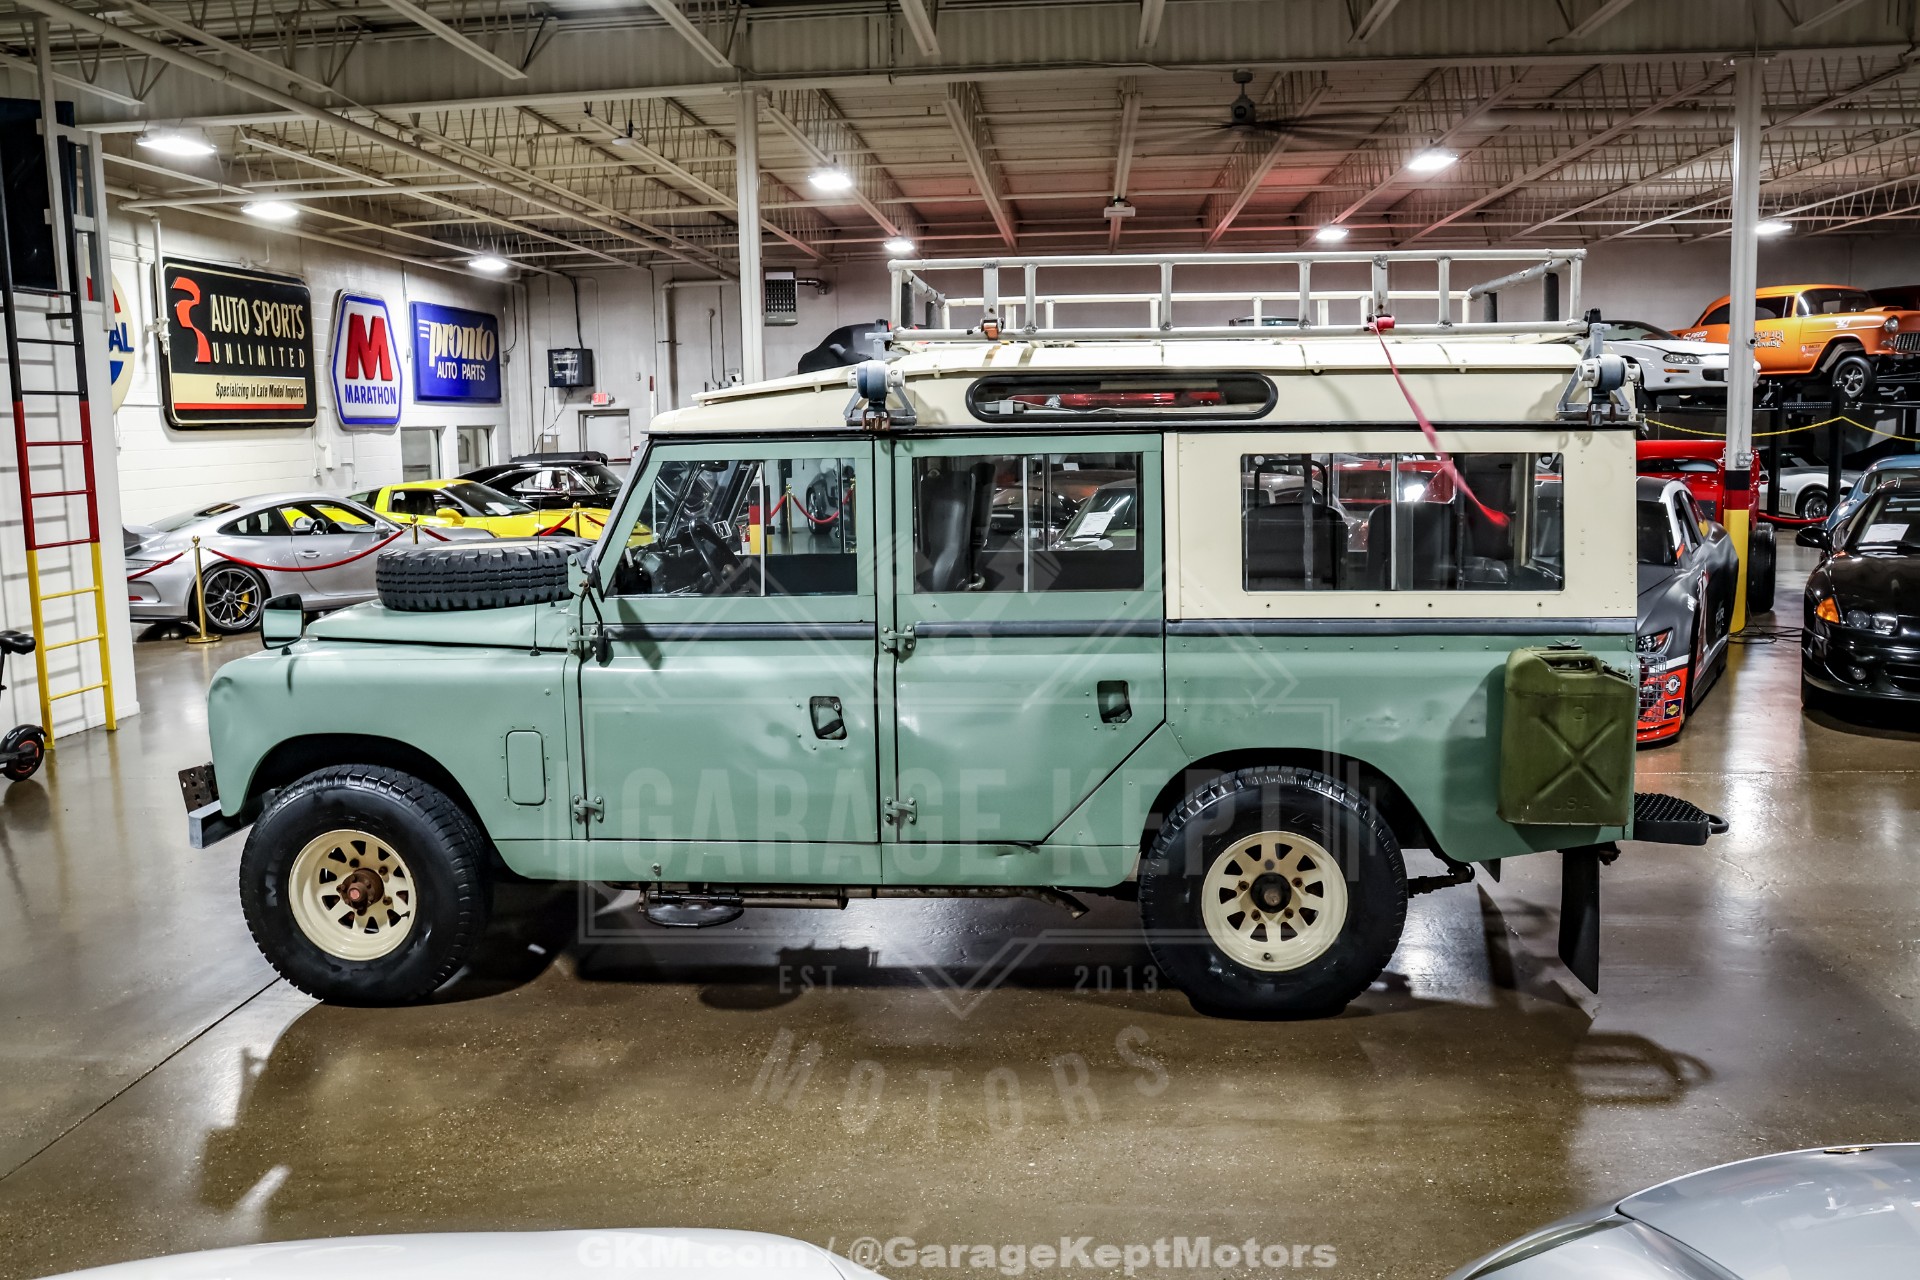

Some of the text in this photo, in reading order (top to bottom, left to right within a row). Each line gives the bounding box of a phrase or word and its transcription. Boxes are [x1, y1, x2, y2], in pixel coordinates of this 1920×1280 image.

[210, 294, 305, 341] AUTO SPORTS
[211, 342, 305, 369] UNLIMITED
[345, 313, 394, 382] M
[428, 320, 496, 367] pronto
[437, 361, 486, 381] AUTO PARTS
[216, 382, 304, 400] Specializing In Late Model Imports
[345, 384, 397, 405] MARATHON
